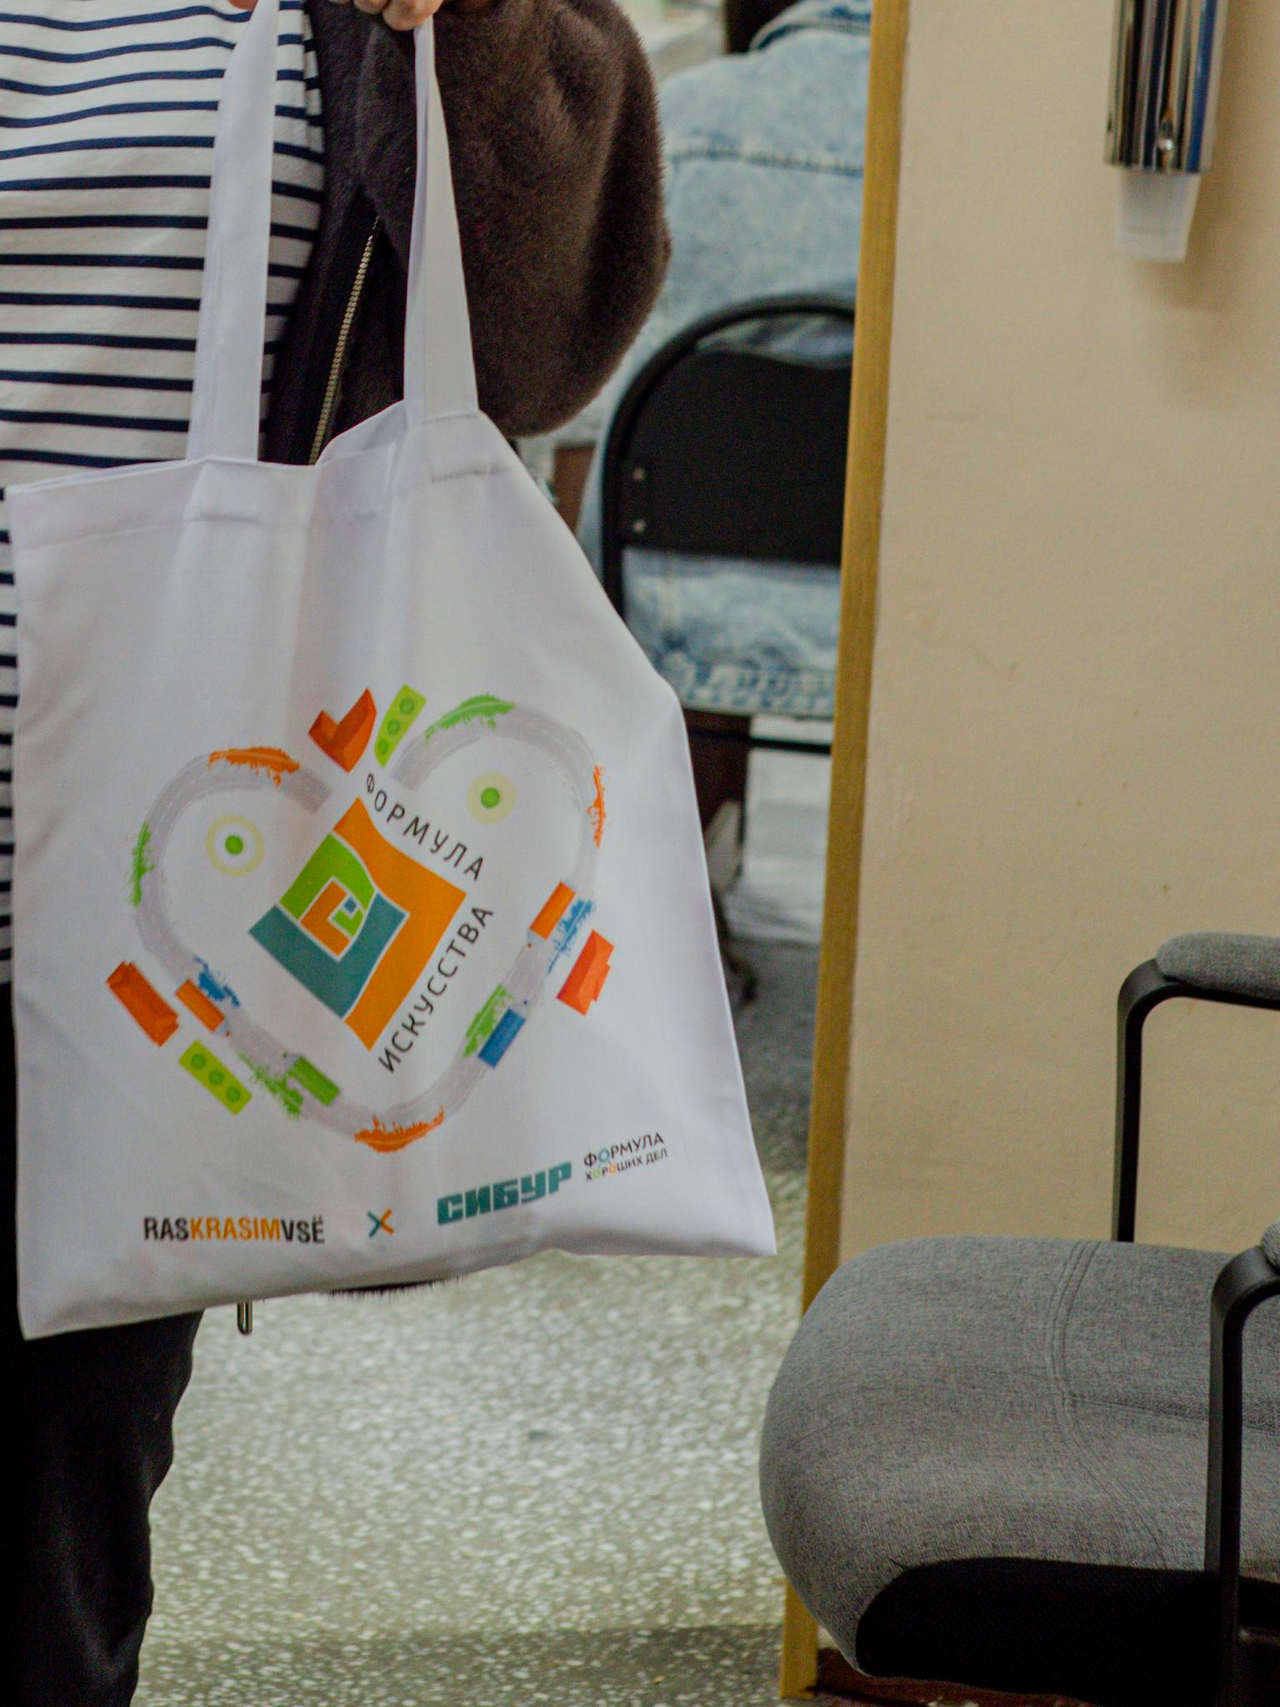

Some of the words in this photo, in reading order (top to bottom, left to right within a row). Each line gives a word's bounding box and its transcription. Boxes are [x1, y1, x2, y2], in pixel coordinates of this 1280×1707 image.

[366, 772, 485, 882] ФОРМУЛА
[378, 906, 494, 1073] ИСКУССТВА
[583, 1131, 665, 1168] ФОРМУЛА
[585, 1155, 644, 1182] ХОРОШИХ
[645, 1147, 669, 1166] ДЕЛ
[437, 1161, 572, 1225] СИБУР
[143, 1214, 325, 1244] RASKRASIMVSË
